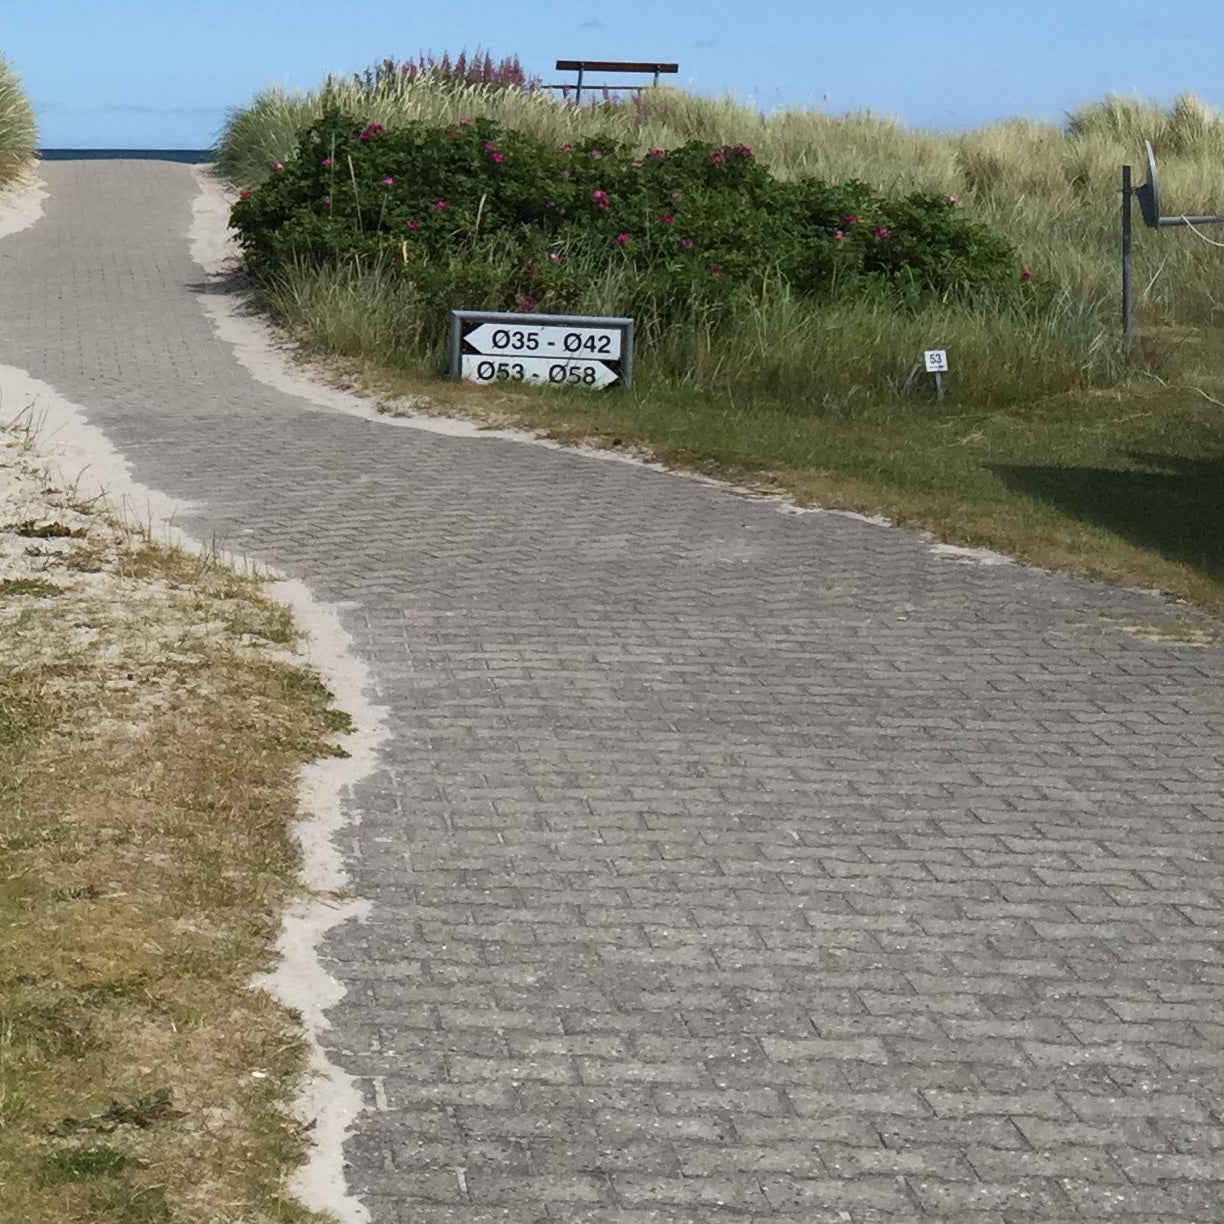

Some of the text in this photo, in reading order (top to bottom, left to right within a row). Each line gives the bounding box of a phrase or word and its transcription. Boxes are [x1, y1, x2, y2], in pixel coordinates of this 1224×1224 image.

[491, 329, 540, 351] Ø35
[563, 332, 612, 354] Ø42
[929, 353, 942, 364] 53
[476, 360, 525, 381] Ø53
[548, 363, 597, 386] Ø58
